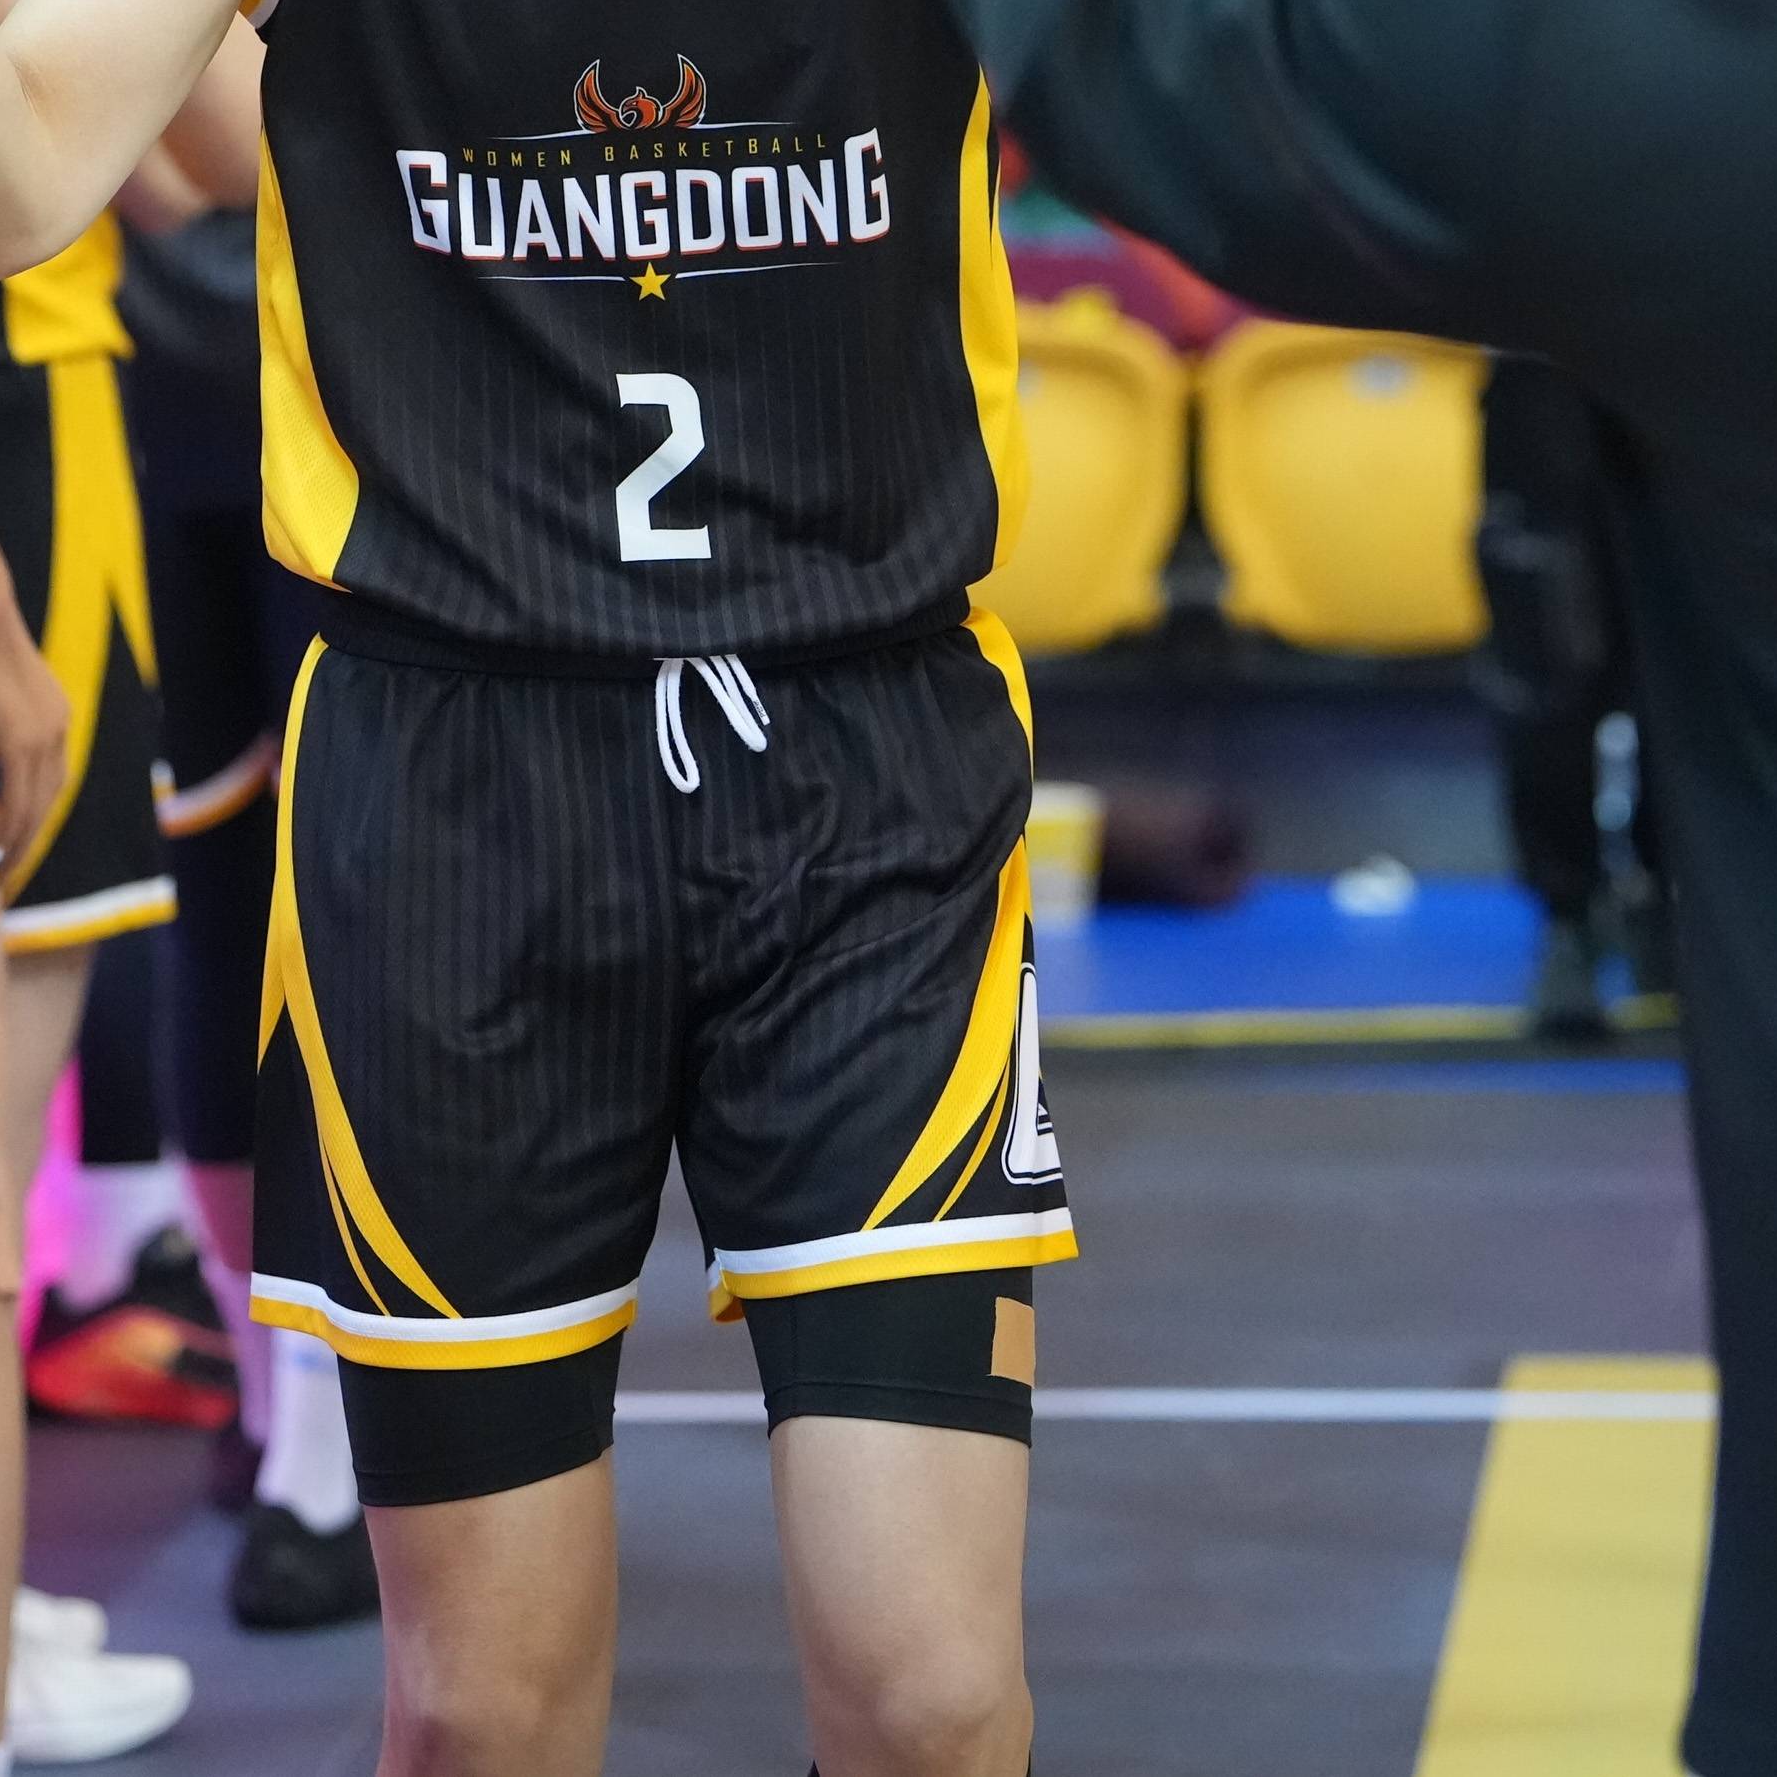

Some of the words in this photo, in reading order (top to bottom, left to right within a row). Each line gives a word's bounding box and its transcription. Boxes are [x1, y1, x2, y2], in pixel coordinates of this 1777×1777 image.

[395, 126, 892, 262] GUANGDONG
[462, 146, 572, 168] WOMEN
[604, 132, 827, 162] BASKETBALL
[615, 372, 712, 562] 2
